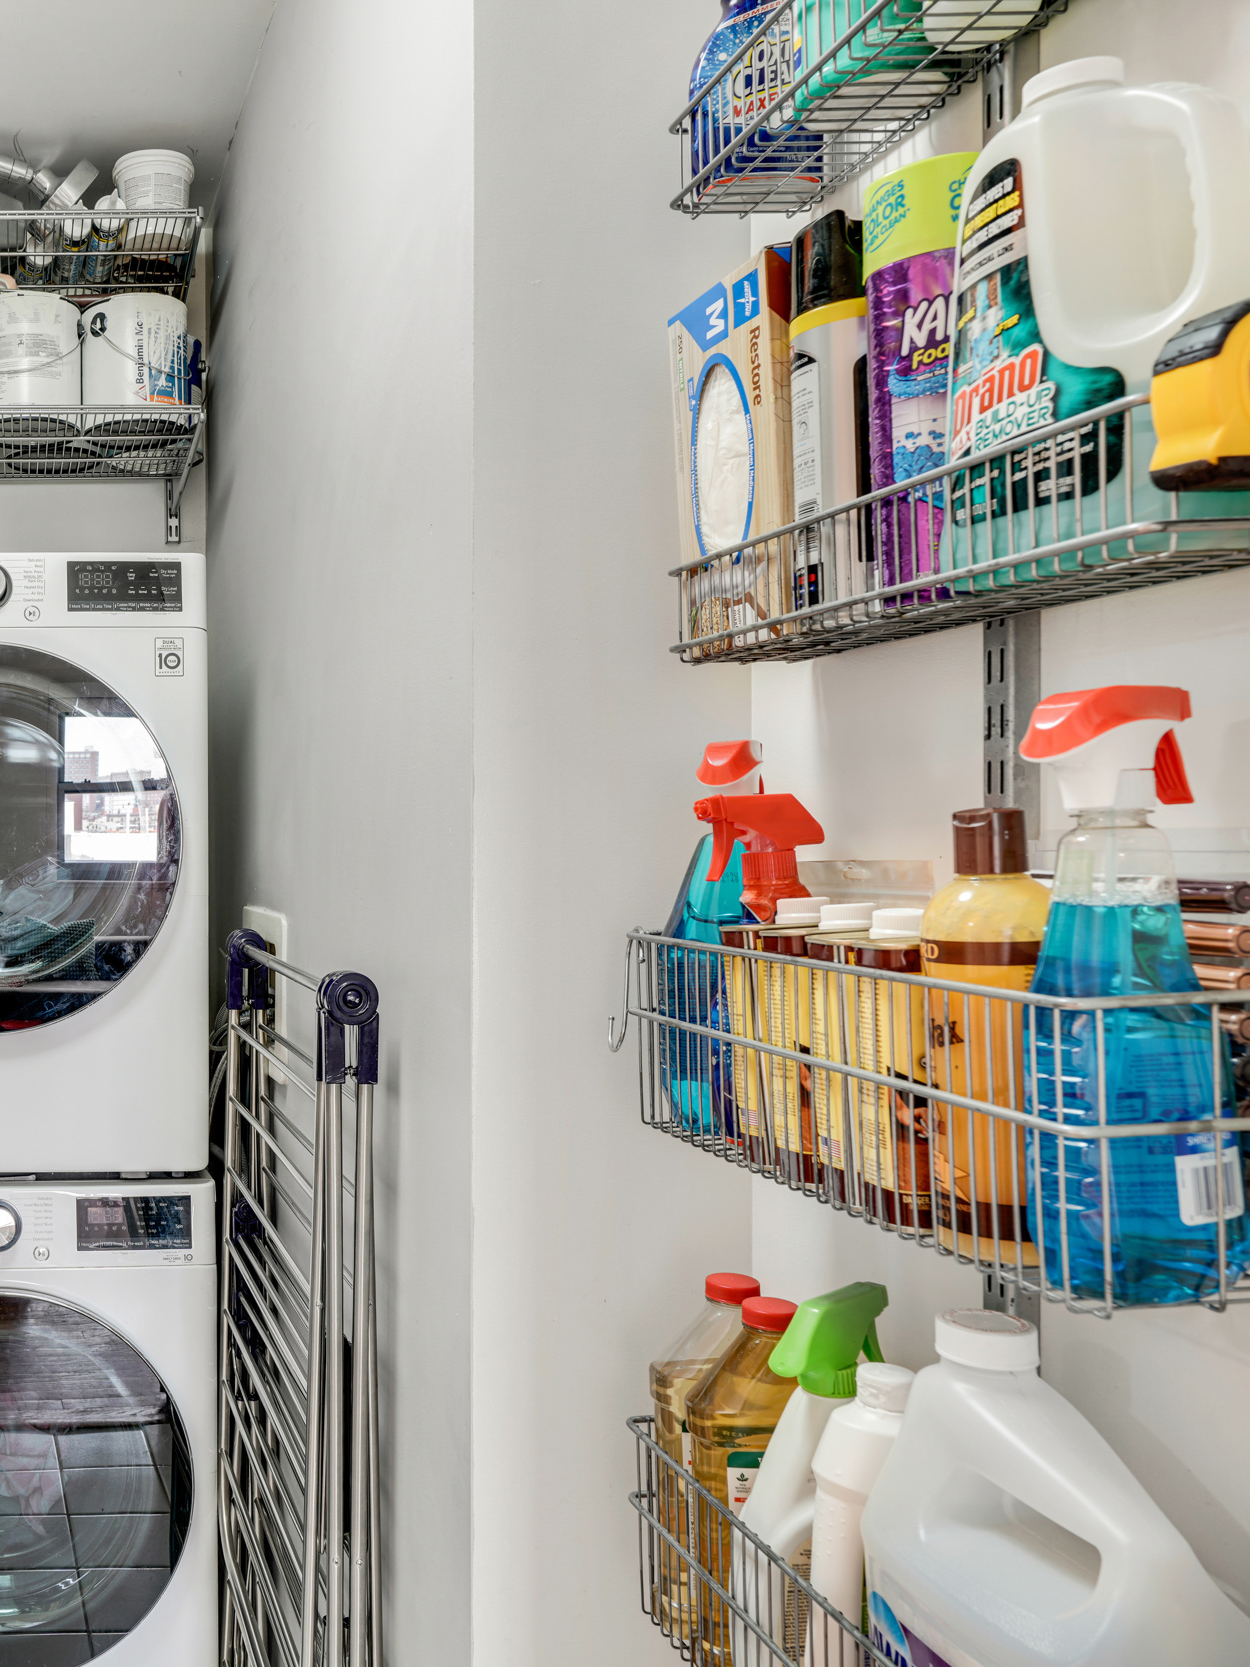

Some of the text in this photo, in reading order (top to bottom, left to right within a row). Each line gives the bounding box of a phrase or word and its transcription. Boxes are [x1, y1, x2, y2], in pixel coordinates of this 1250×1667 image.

[733, 60, 792, 99] CLEA
[705, 297, 726, 340] M
[134, 340, 145, 385] Benjamin
[750, 324, 762, 407] Restore
[974, 405, 1051, 454] REMOVER
[975, 387, 1051, 438] BUILD-UP
[158, 652, 181, 670] 10
